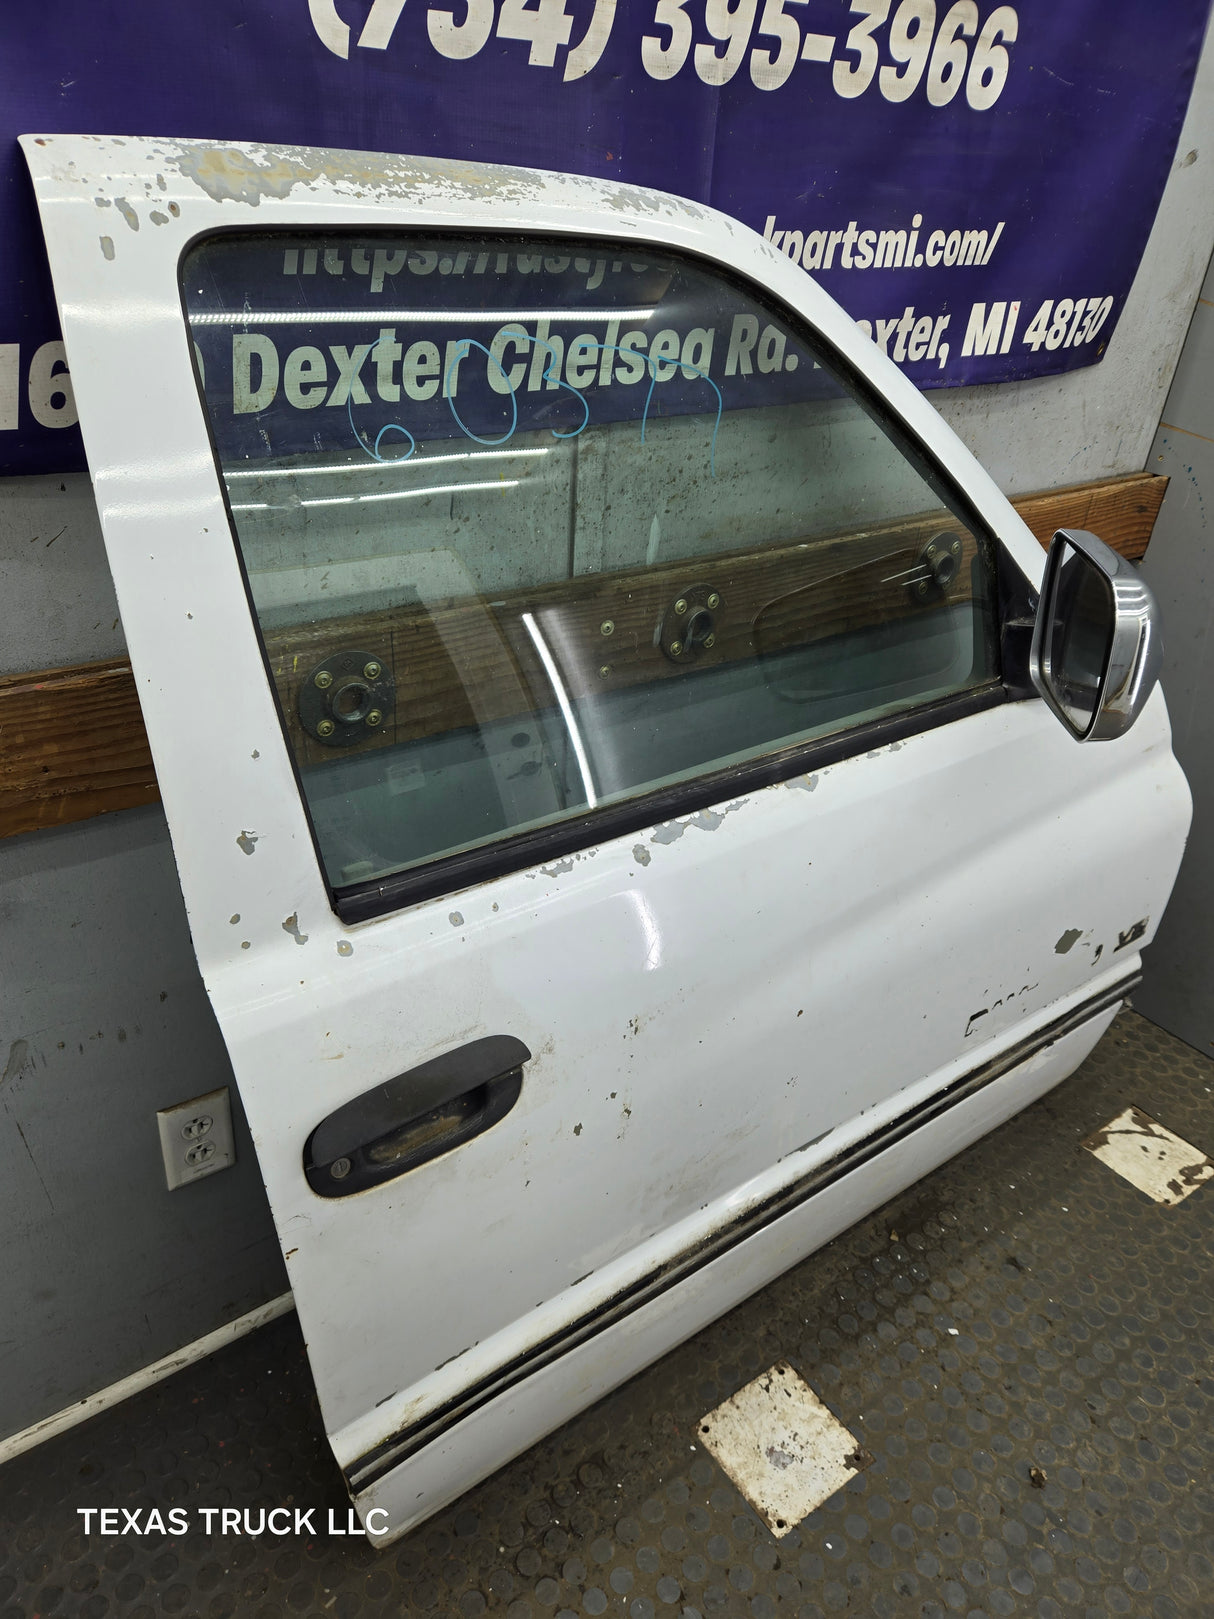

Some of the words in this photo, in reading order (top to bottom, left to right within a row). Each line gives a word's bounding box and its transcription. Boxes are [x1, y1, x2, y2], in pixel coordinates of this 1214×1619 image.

[641, 0, 1020, 111] 395-3966
[232, 327, 470, 415] Dexter
[486, 318, 715, 395] Chelsea
[960, 301, 1021, 358] MI
[1022, 295, 1114, 353] 48130
